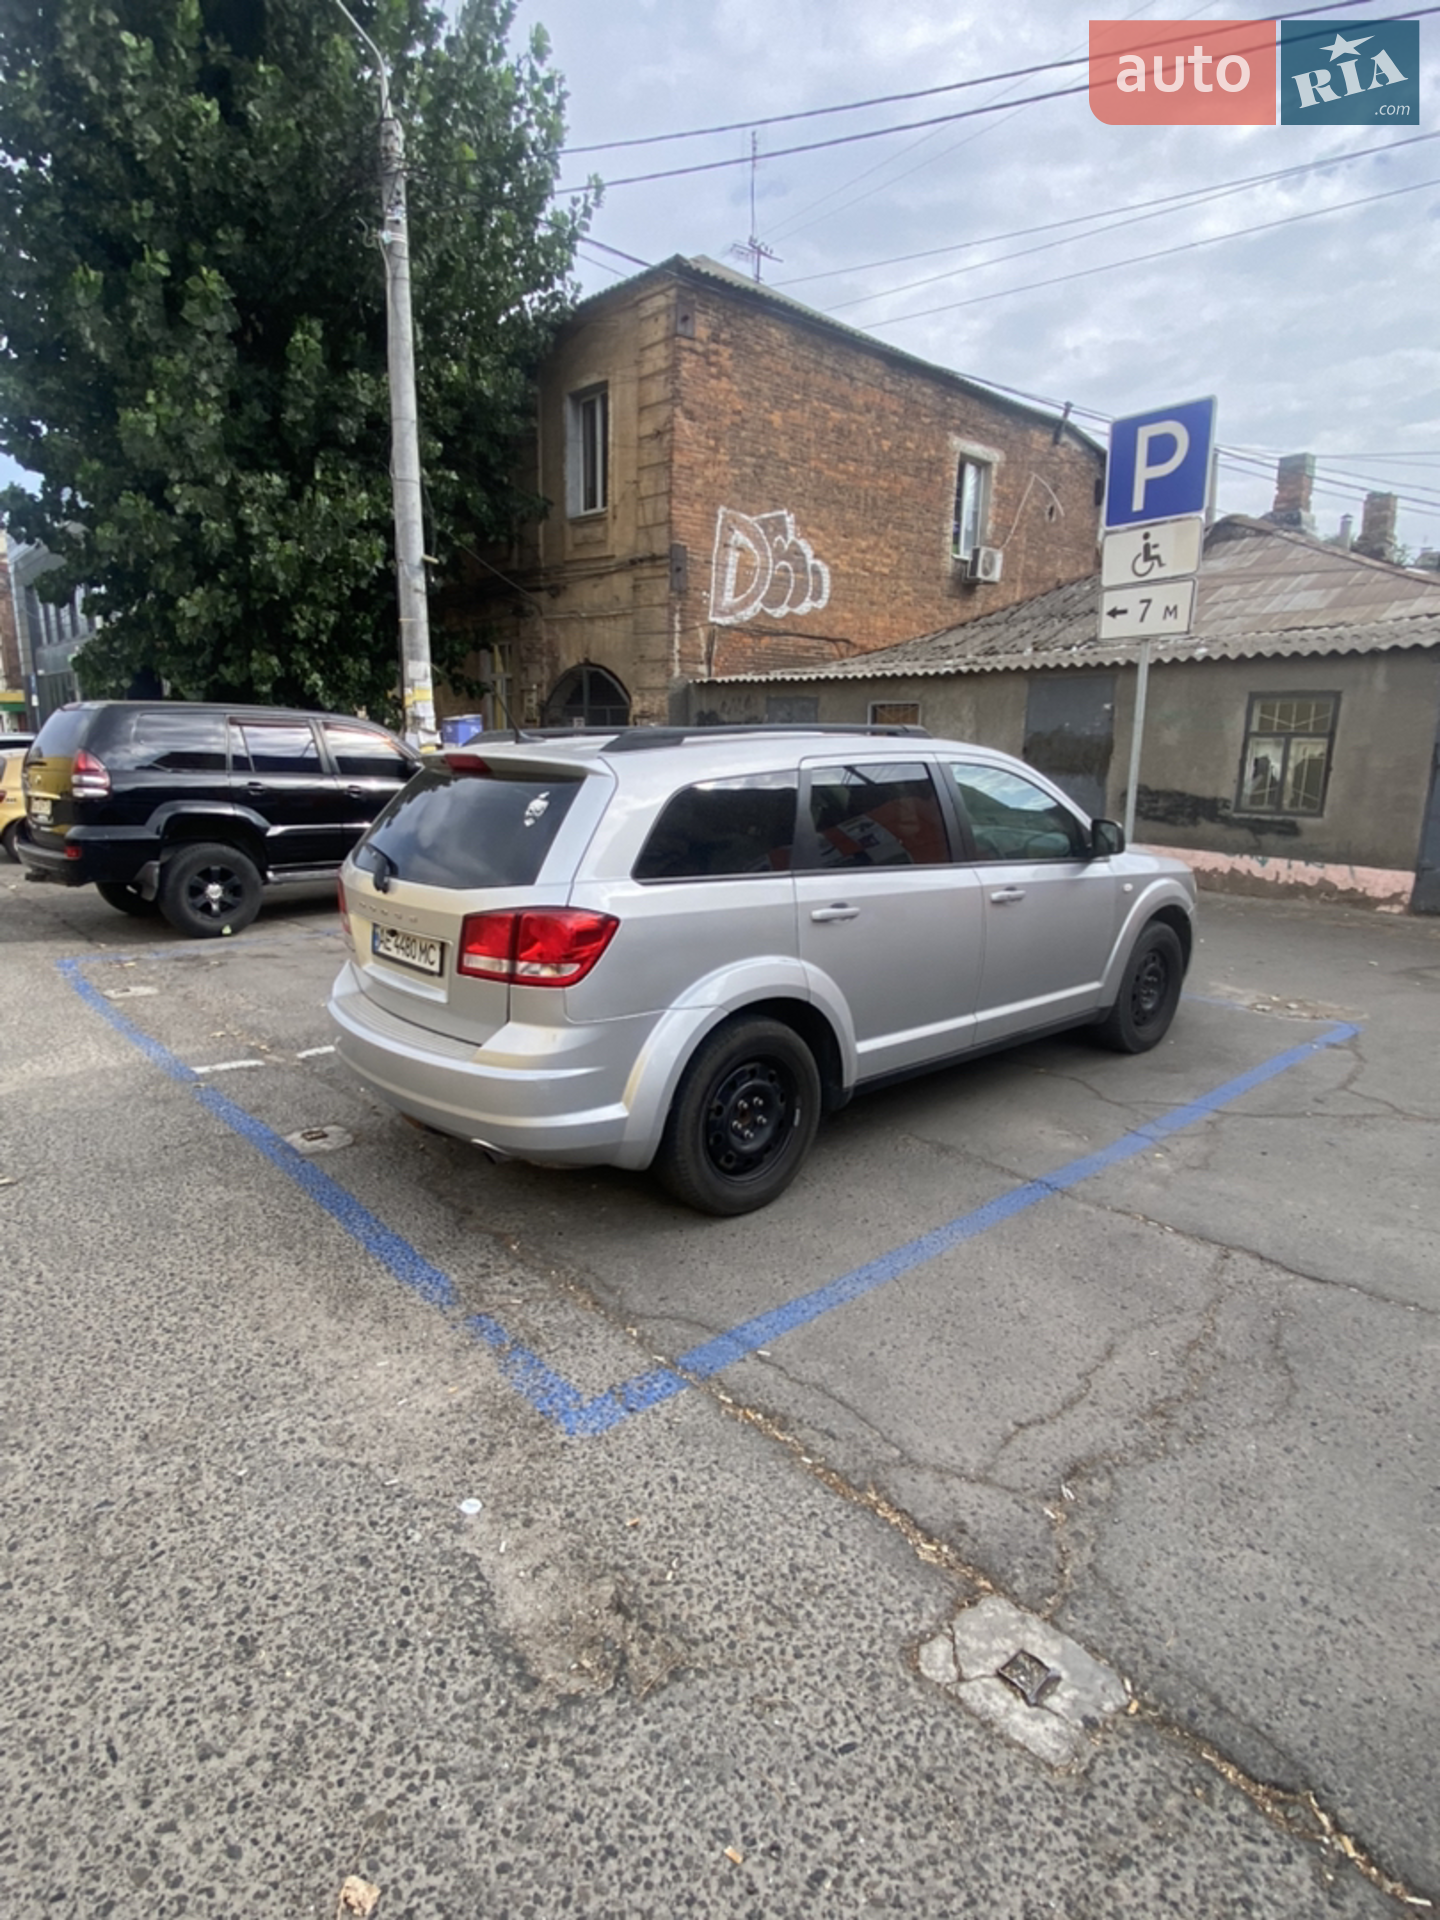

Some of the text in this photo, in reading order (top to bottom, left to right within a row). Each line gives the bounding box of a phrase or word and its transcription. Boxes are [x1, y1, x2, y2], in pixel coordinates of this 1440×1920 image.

[1131, 420, 1190, 513] P
[1138, 598, 1153, 623] 7
[393, 934, 417, 960] 4480
[419, 941, 436, 966] MC
